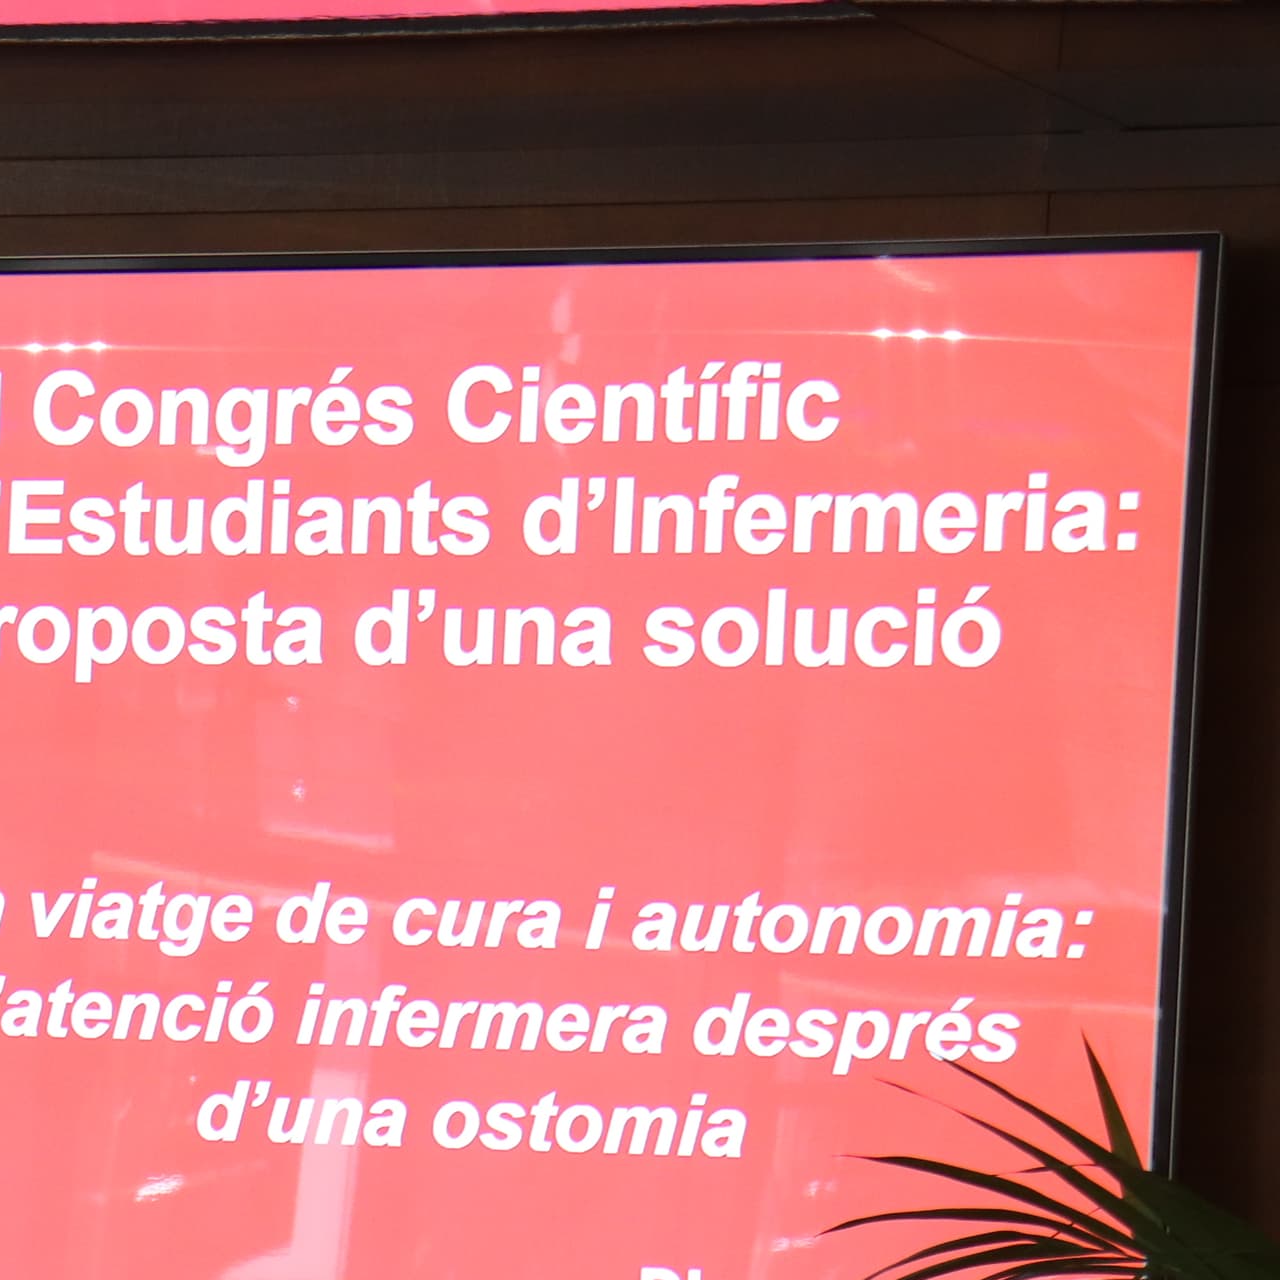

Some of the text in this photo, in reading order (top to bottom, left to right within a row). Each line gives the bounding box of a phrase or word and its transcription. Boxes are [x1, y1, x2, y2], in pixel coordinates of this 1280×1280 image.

[32, 365, 415, 468] Congrés
[446, 360, 841, 445] Científic
[522, 472, 1140, 557] d’Infermeria:
[353, 587, 612, 668] d’una
[642, 584, 1003, 669] solució
[30, 876, 255, 958] viatge
[275, 881, 370, 946] de
[392, 896, 561, 951] cura
[585, 886, 616, 951] i
[631, 890, 1095, 961] autonomia:
[295, 982, 669, 1056] infermera
[692, 990, 1023, 1077] després
[196, 1078, 749, 1160] d’una ostomia
